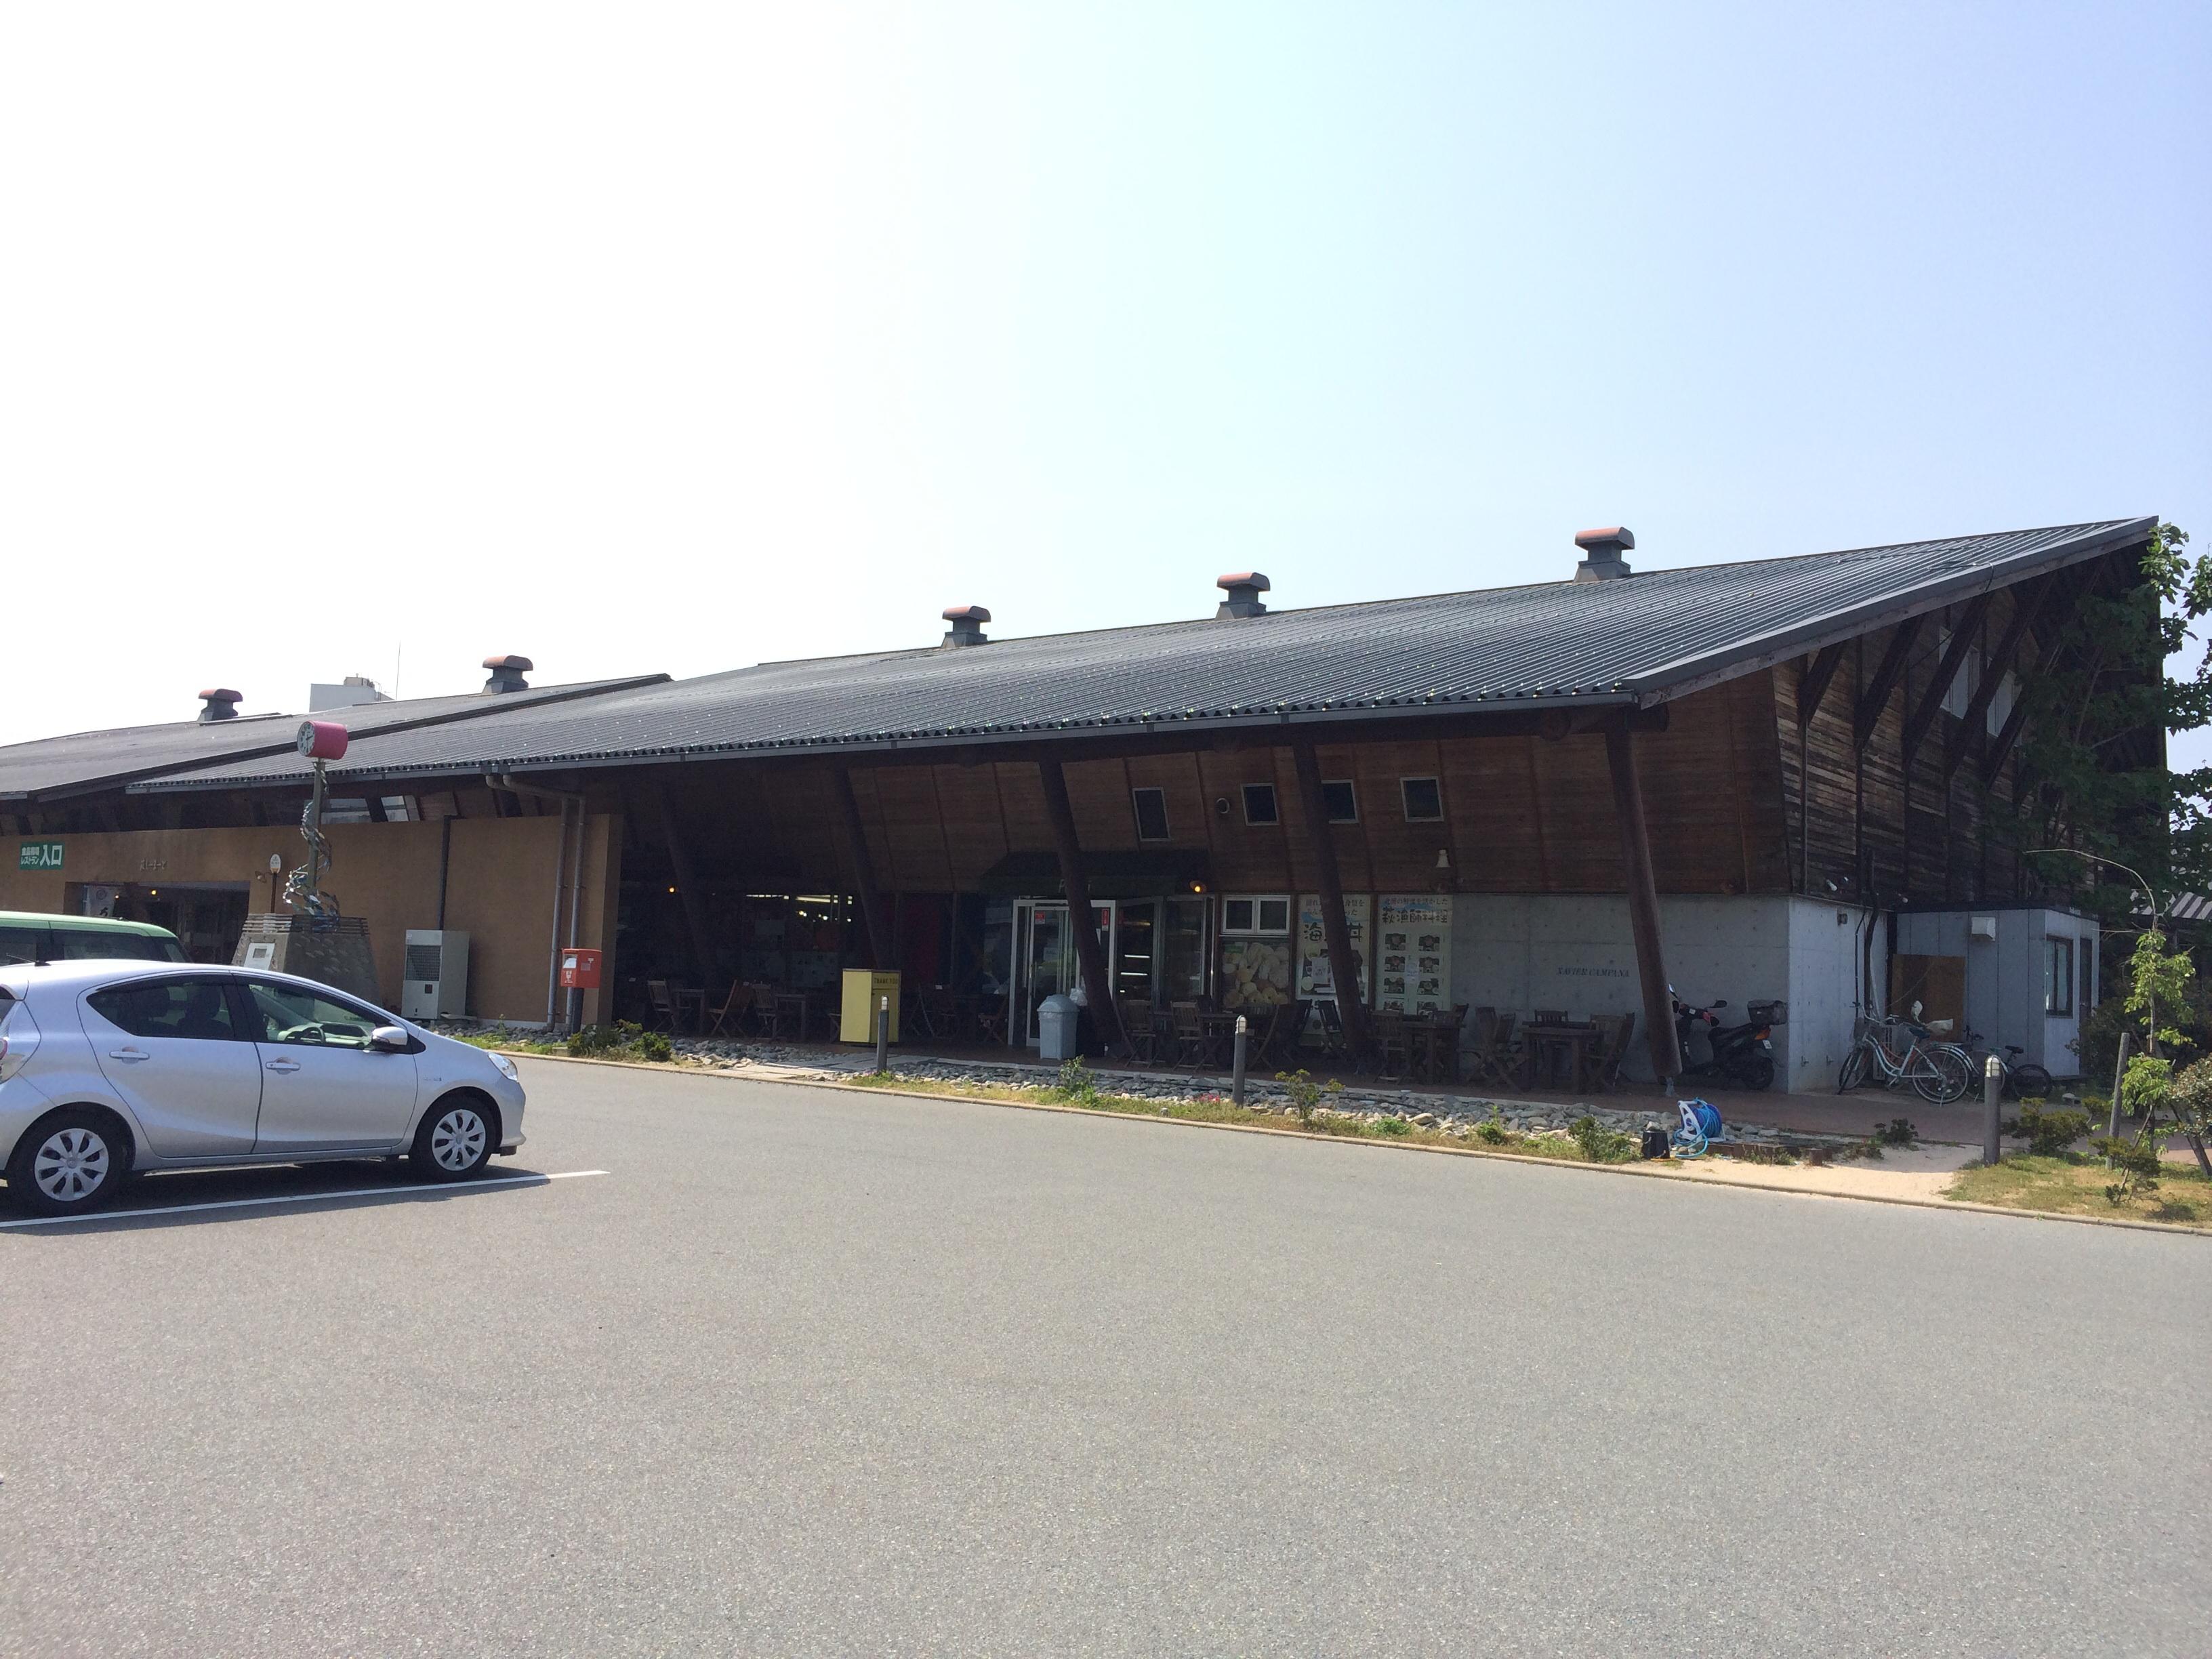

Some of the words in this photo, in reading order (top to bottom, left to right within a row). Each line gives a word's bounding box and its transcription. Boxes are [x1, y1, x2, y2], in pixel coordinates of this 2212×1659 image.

[21, 856, 39, 865] レストラン
[39, 844, 62, 866] 入口
[1382, 906, 1448, 924] 萩漁師料理
